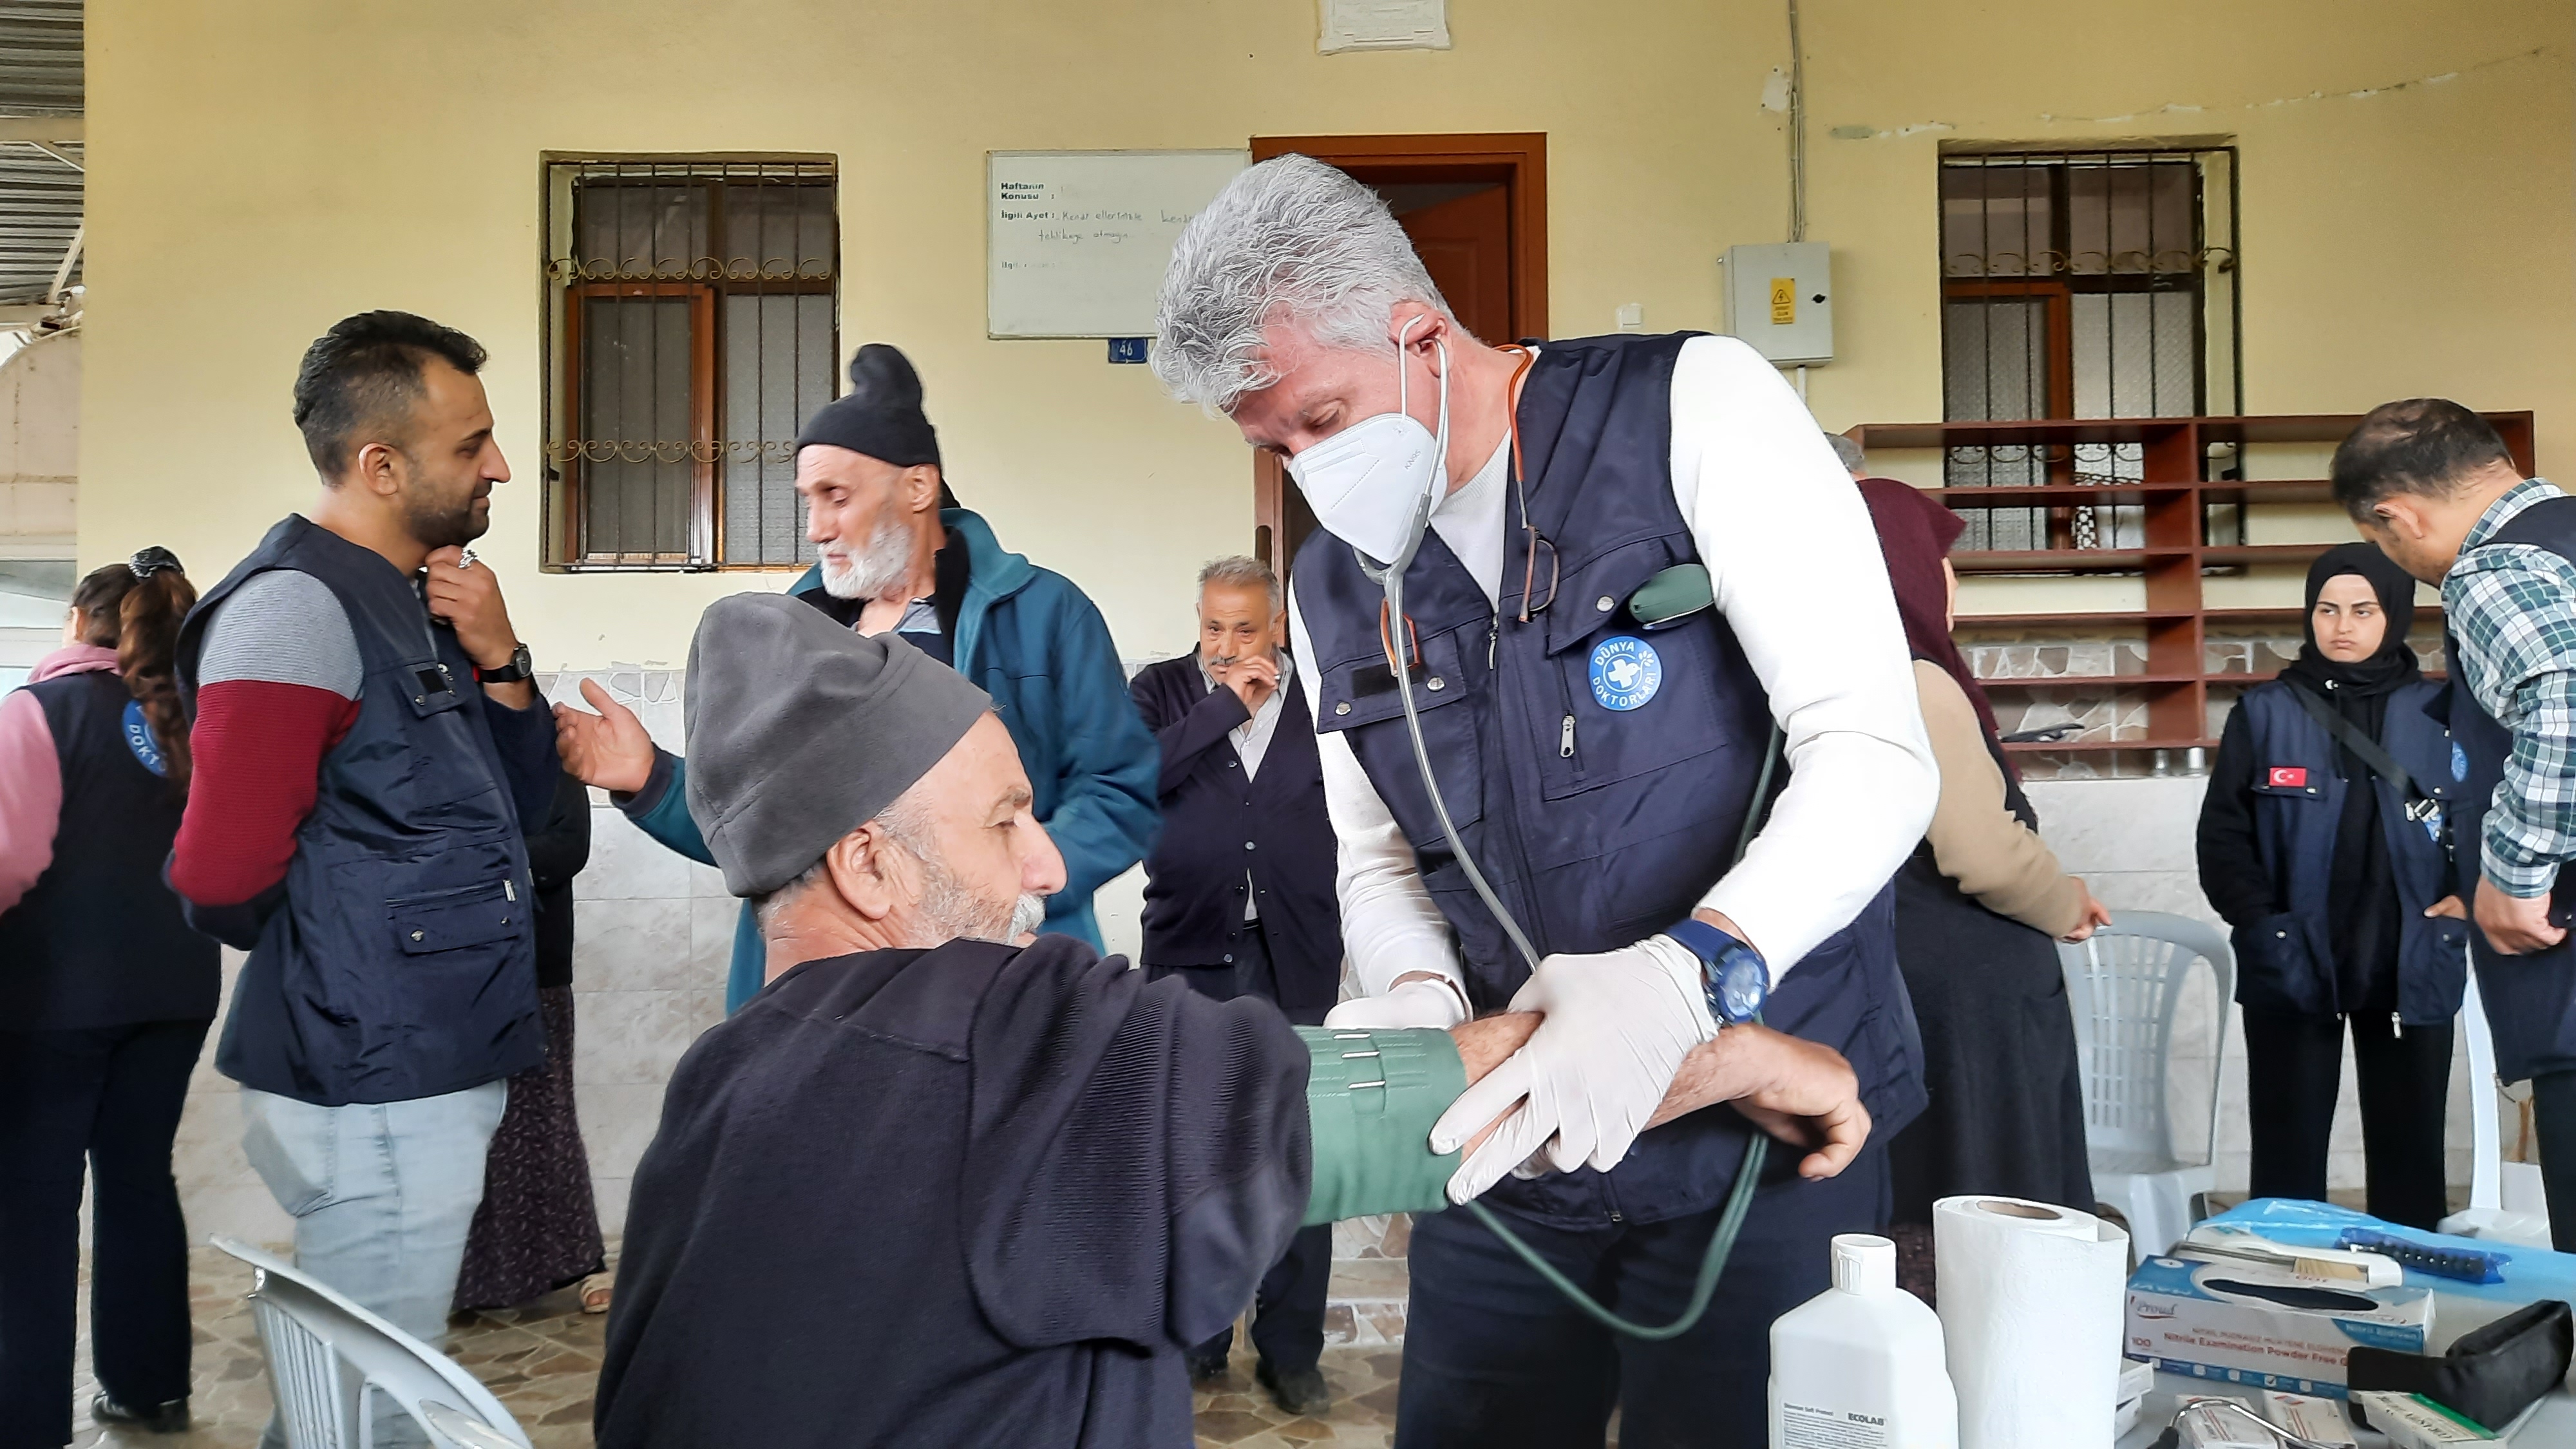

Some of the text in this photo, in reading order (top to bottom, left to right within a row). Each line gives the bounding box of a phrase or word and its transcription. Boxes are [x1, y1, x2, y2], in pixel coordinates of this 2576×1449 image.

[1119, 339, 1133, 356] 46
[1595, 641, 1634, 666] DÜNYA
[1593, 672, 1656, 706] DOKTORLARI
[2199, 1336, 2264, 1353] Examination
[2267, 1346, 2309, 1359] Powder
[2311, 1353, 2337, 1365] Free
[1848, 1412, 1884, 1426] ECOLAB
